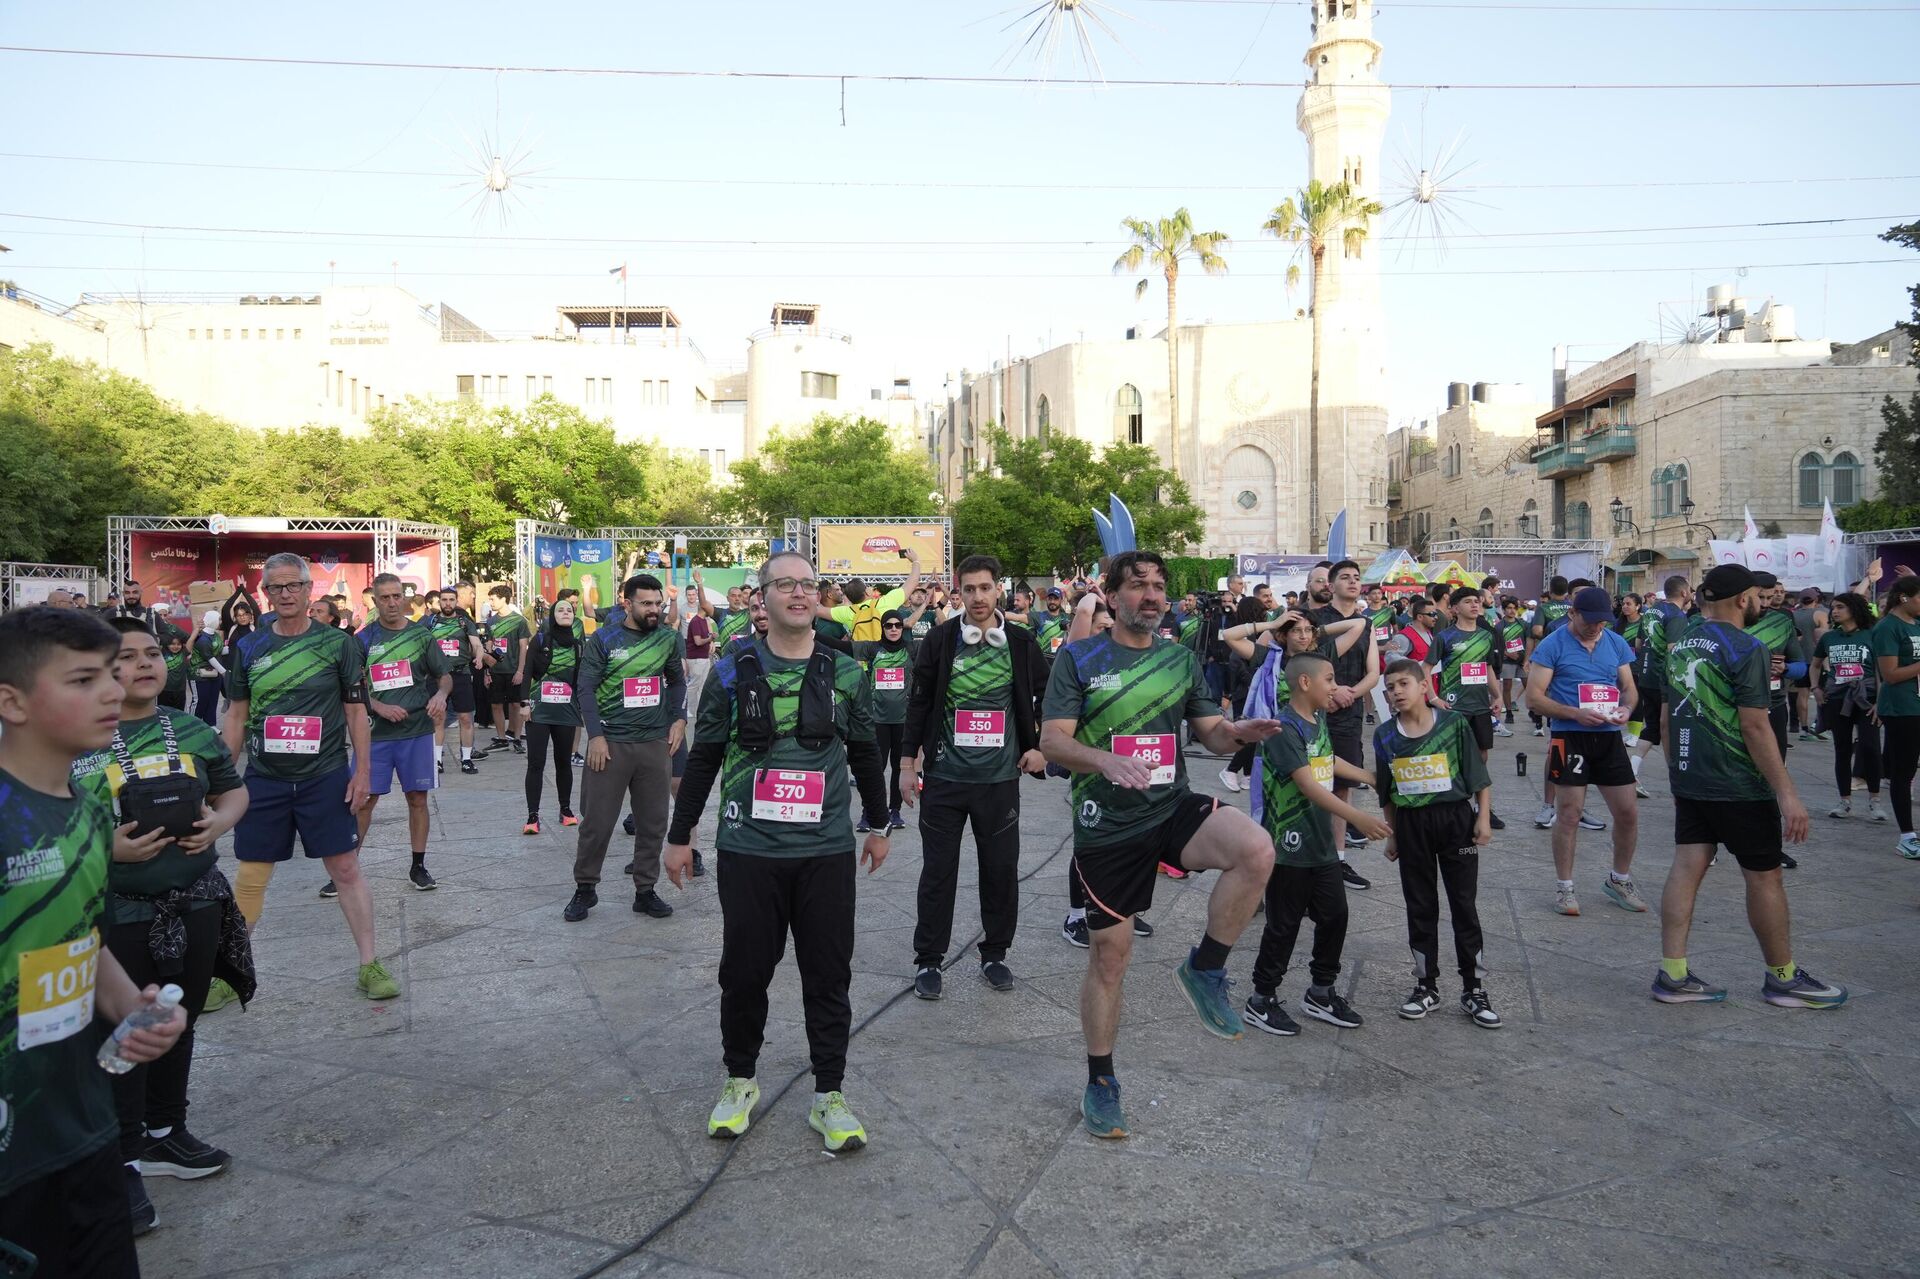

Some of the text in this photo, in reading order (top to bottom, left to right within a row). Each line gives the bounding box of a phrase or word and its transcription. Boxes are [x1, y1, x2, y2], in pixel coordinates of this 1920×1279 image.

[866, 538, 897, 547] HEBRON
[381, 669, 400, 678] 716
[1090, 673, 1121, 684] PALESTINE
[635, 686, 651, 694] 729
[1591, 691, 1609, 700] 693
[280, 725, 306, 737] 714
[969, 720, 992, 731] 350
[286, 741, 297, 749] 21
[72, 753, 111, 769] PALESTINE
[73, 758, 112, 776] MARATHON
[773, 783, 806, 799] 370
[780, 805, 794, 816] 21
[6, 846, 63, 870] PALESTINE
[7, 858, 65, 881] MARATHON
